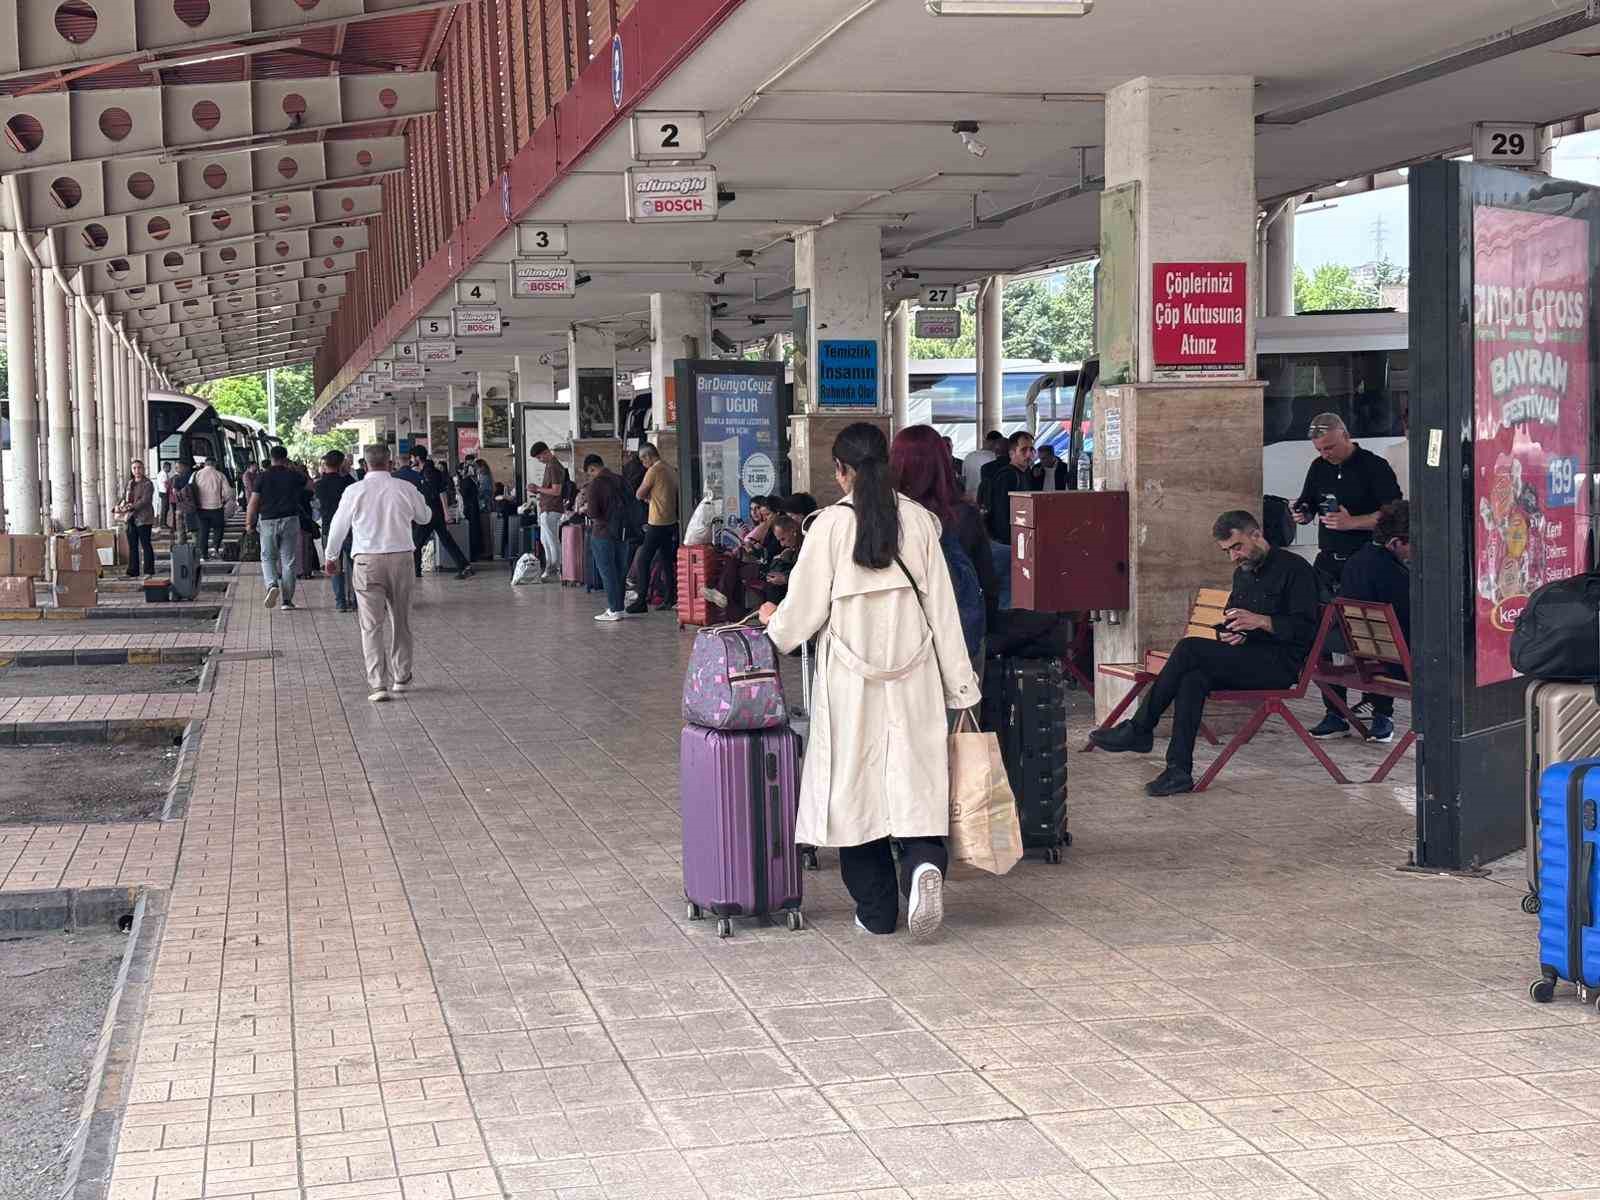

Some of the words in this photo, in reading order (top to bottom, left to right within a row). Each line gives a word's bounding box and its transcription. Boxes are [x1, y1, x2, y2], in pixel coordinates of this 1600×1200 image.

[660, 124, 680, 148] 2
[1491, 133, 1525, 155] 29
[654, 200, 703, 212] BOSCH
[535, 231, 549, 248] 3
[530, 282, 565, 291] BOSCH
[1166, 271, 1233, 299] Çöplerinizi
[470, 286, 481, 298] 4
[929, 290, 948, 302] 27
[1155, 302, 1180, 330] Çöp
[1184, 303, 1242, 325] Kutusuna
[430, 322, 438, 332] 5
[467, 324, 495, 332] BOSCH
[403, 345, 411, 355] 6
[1180, 333, 1217, 355] Atınız
[383, 362, 389, 370] 7
[1490, 349, 1568, 396] BAYRAM
